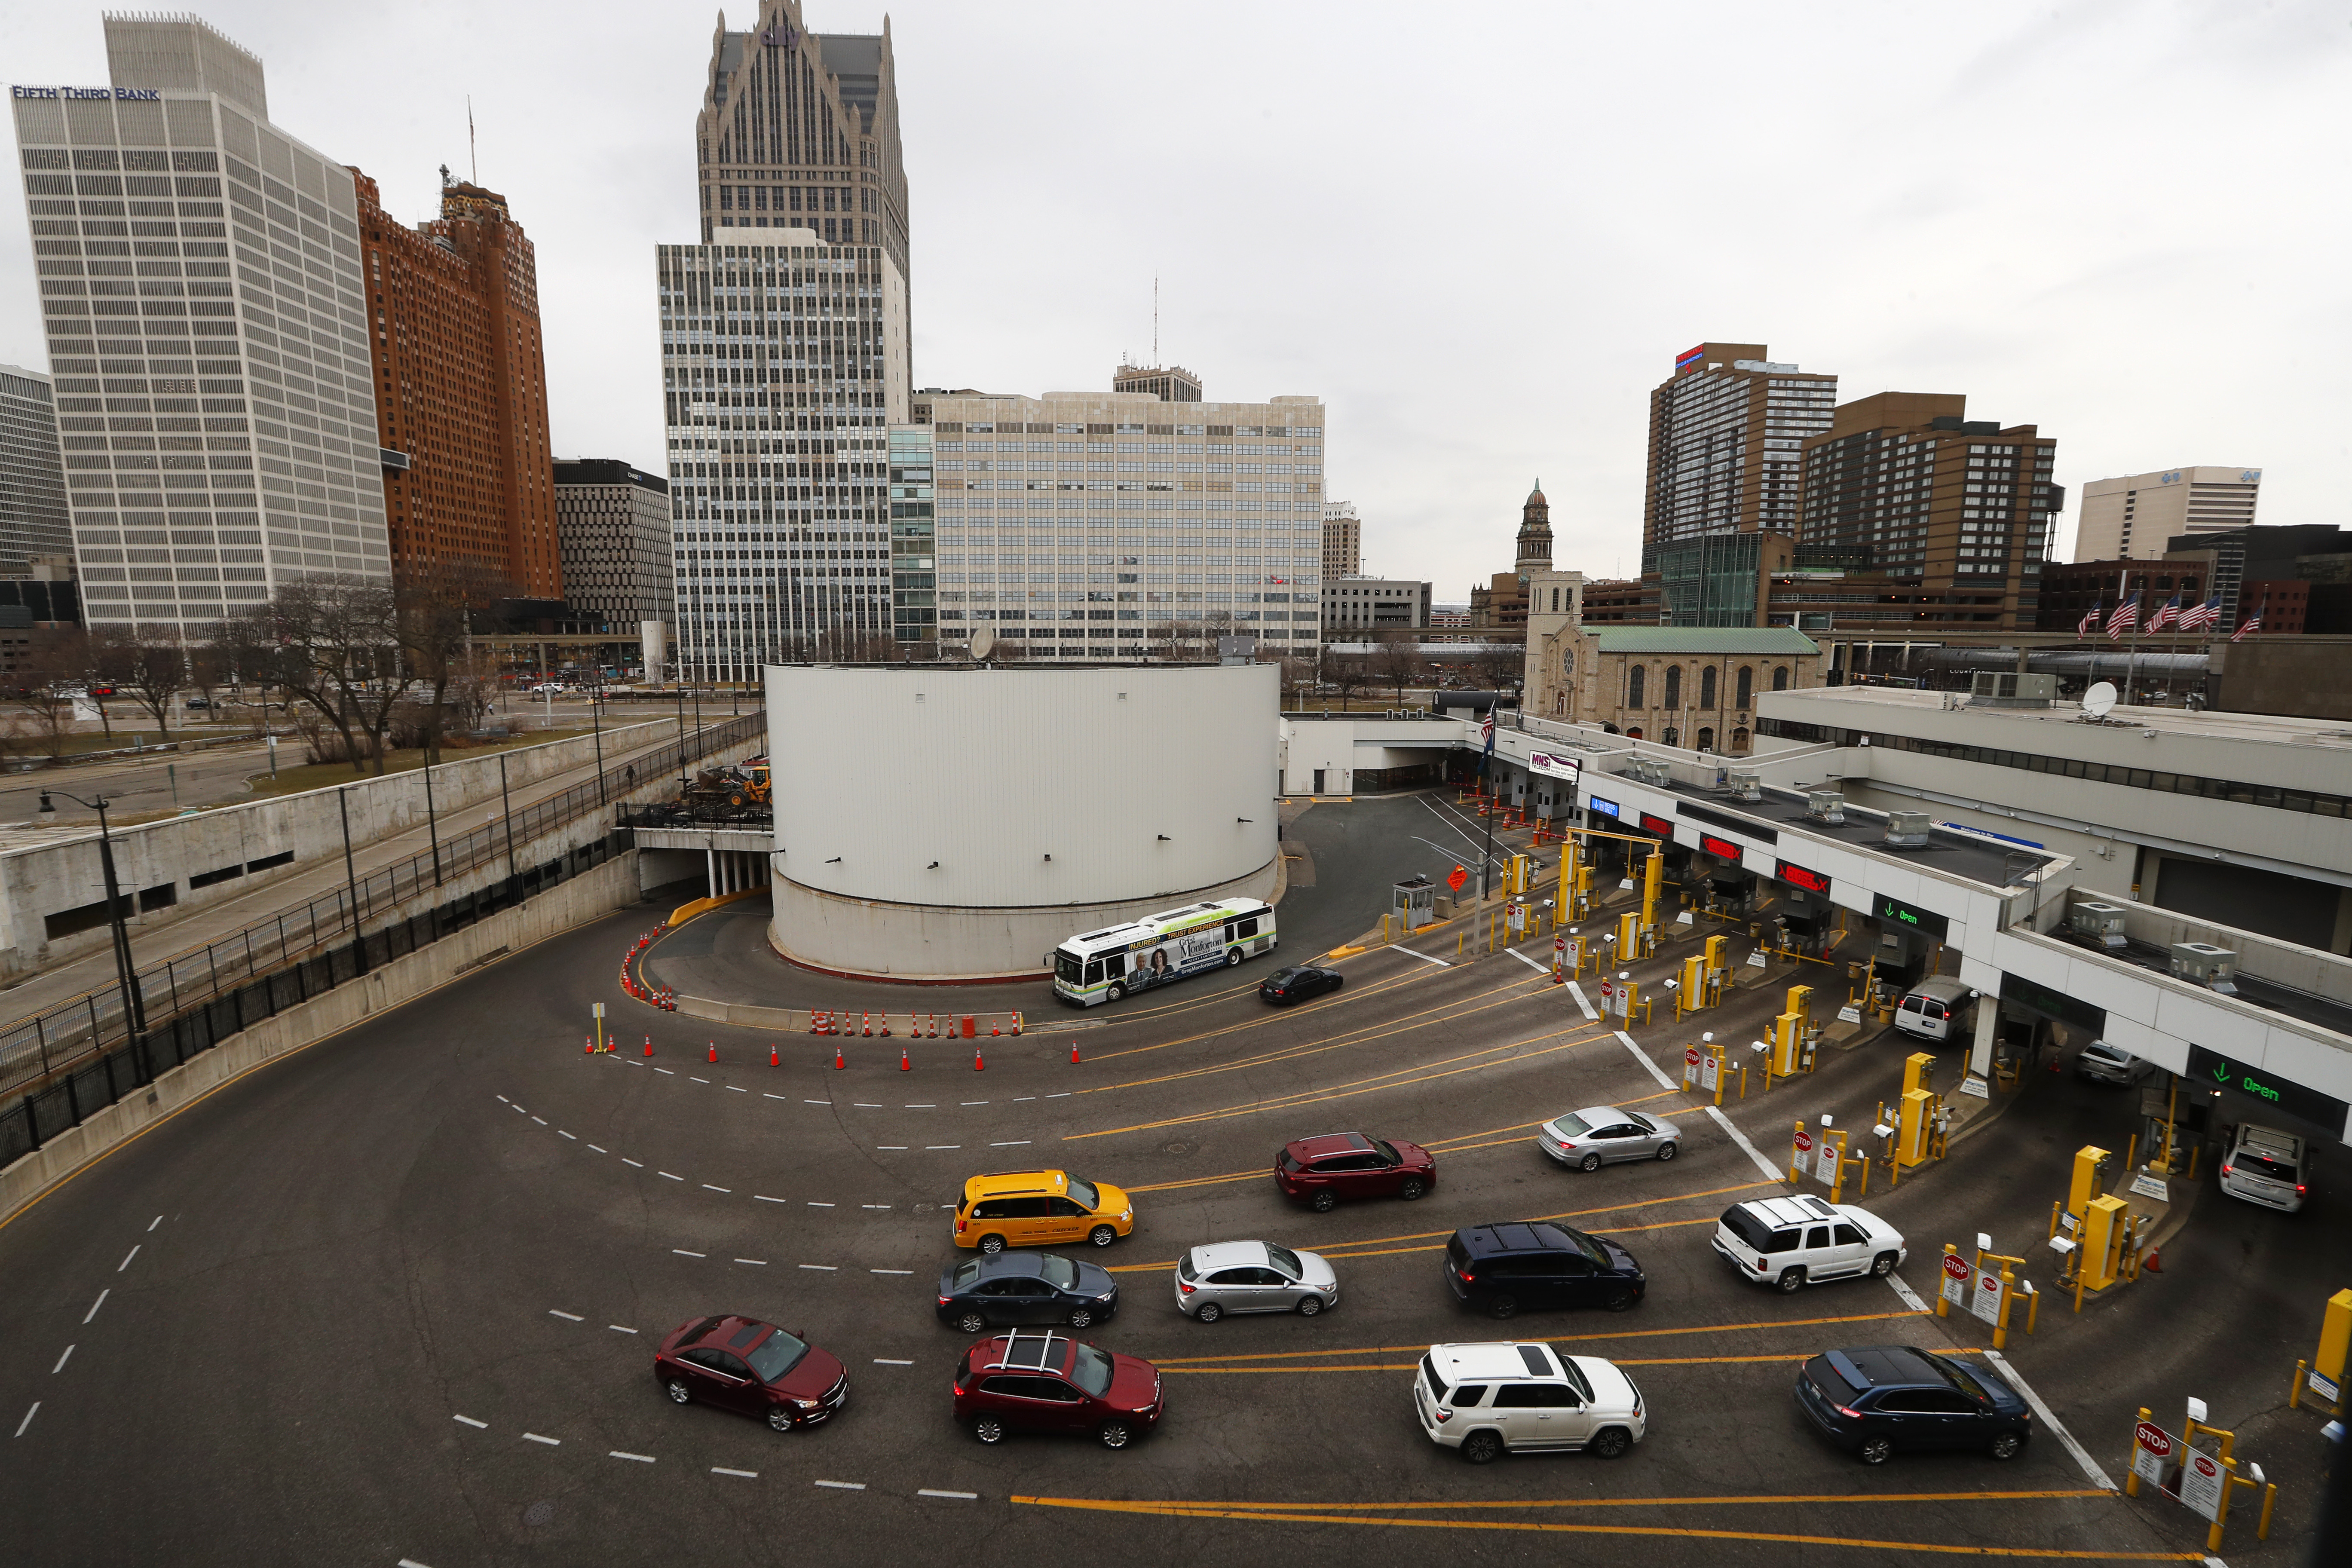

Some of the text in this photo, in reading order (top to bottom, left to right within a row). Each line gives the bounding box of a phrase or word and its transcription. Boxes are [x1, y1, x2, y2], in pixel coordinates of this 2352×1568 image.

[12, 86, 161, 101] FIFTH THIRD BANK
[1677, 344, 1703, 363] RENAISSANCE
[1605, 802, 1615, 810] NEXUS
[1647, 818, 1667, 833] CLOSED
[1709, 840, 1733, 857] CLOSED
[1900, 910, 1917, 924] Open
[1170, 922, 1188, 930] HYBRID
[1129, 919, 1224, 950] INJURED? TRUST EXPERIENCE
[1179, 936, 1196, 946] Greg
[1180, 939, 1222, 959] Monforton
[1181, 959, 1224, 974] GregMonforton.com
[1686, 1052, 1699, 1062] STOP
[2243, 1077, 2279, 1101] Open
[1795, 1136, 1811, 1147] STOP
[1945, 1259, 1967, 1274] STOP
[1983, 1280, 1996, 1289] STOP
[2138, 1427, 2168, 1450] STOP
[2195, 1460, 2214, 1473] STOP
